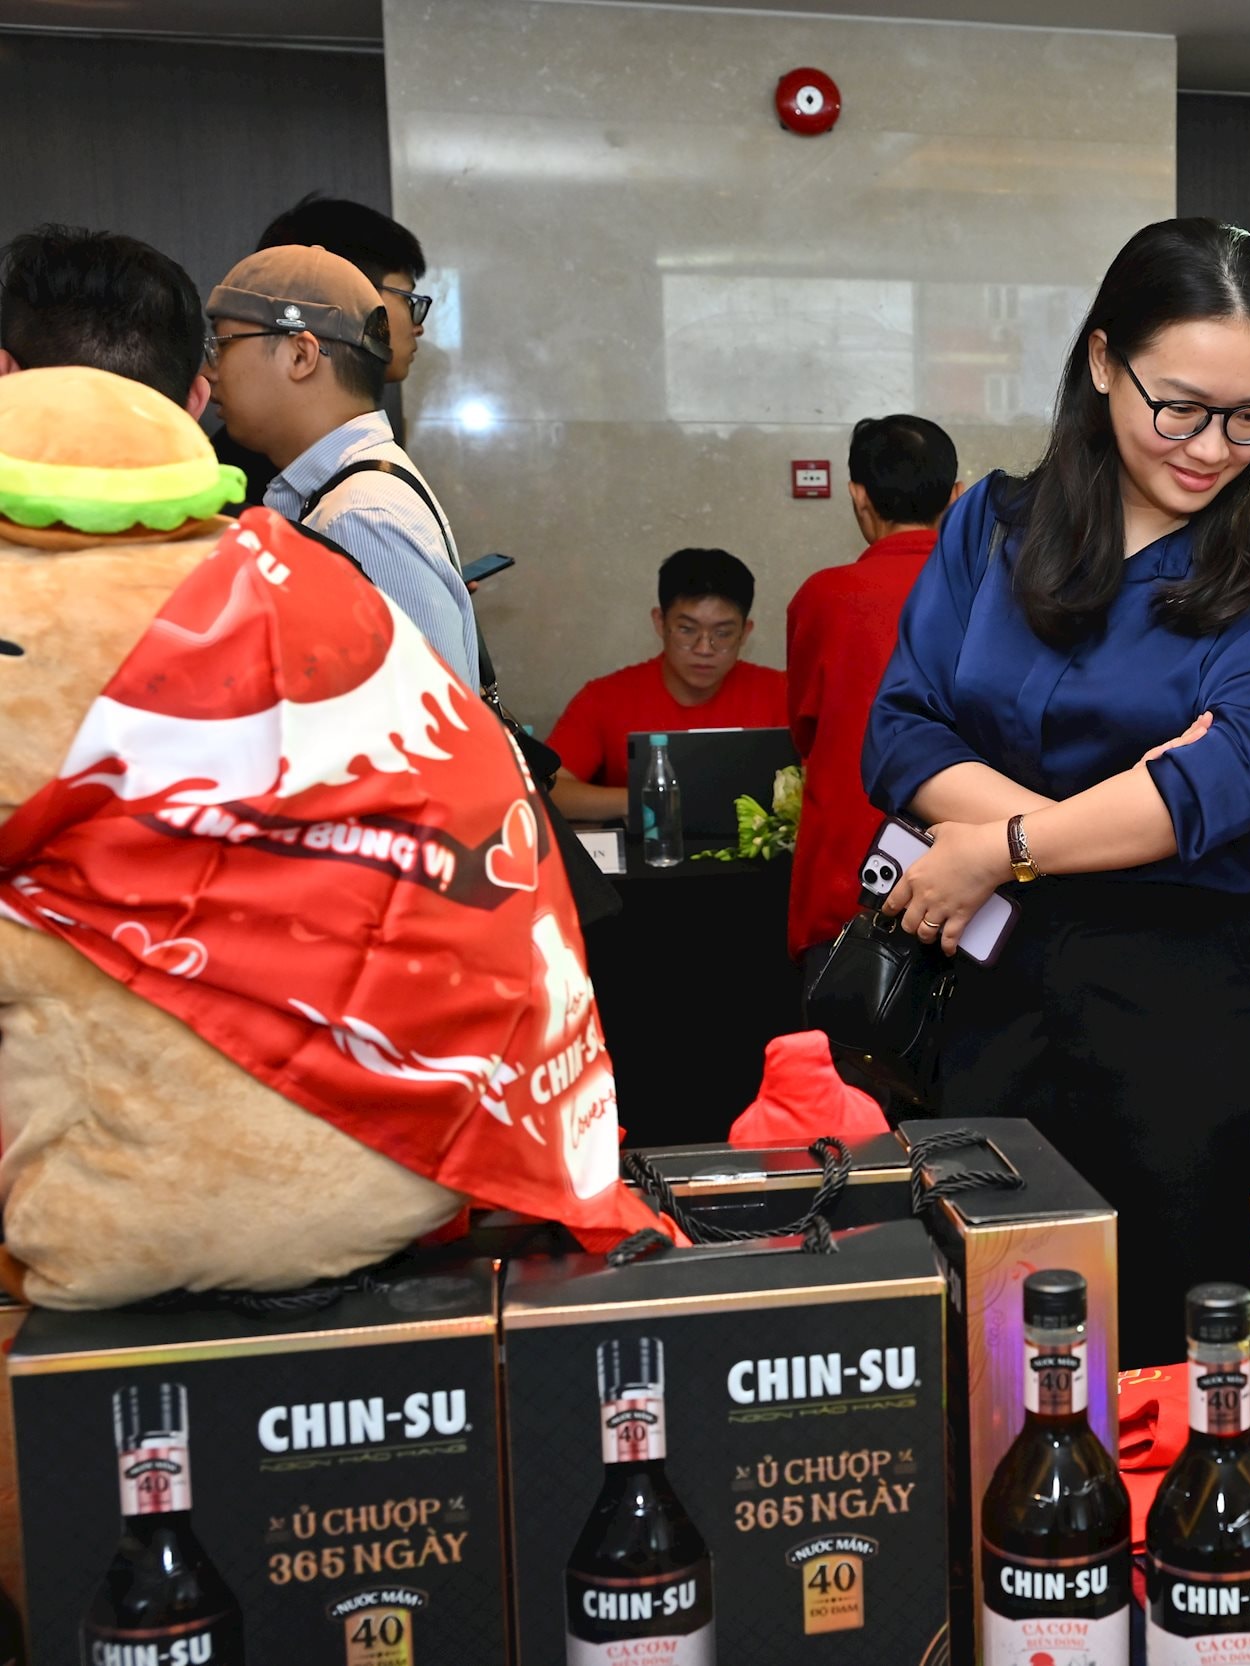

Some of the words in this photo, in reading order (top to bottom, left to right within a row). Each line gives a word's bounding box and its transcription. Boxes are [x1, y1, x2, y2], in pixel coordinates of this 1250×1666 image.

[727, 1346, 917, 1403] CHIN-SU
[1040, 1371, 1070, 1392] 40
[1208, 1390, 1238, 1411] 40
[259, 1389, 466, 1452] CHIN-SU
[619, 1426, 645, 1443] 40
[138, 1476, 168, 1493] 40
[756, 1455, 778, 1488] Ủ
[784, 1450, 892, 1483] CHƯỢP
[293, 1505, 316, 1539] Ủ
[322, 1498, 441, 1534] CHƯỢP
[735, 1496, 804, 1531] 365
[811, 1482, 915, 1523] NGÀY
[269, 1547, 346, 1585] 365
[353, 1527, 468, 1575] NGÀY
[796, 1540, 834, 1561] NƯỚC
[808, 1562, 857, 1594] 40
[1000, 1565, 1109, 1600] CHIN-SU
[583, 1579, 696, 1622] CHIN-SU
[352, 1615, 404, 1648] 40
[1022, 1621, 1042, 1636] CÁ
[1046, 1621, 1089, 1636] CƠM
[1195, 1637, 1218, 1652] CÁ
